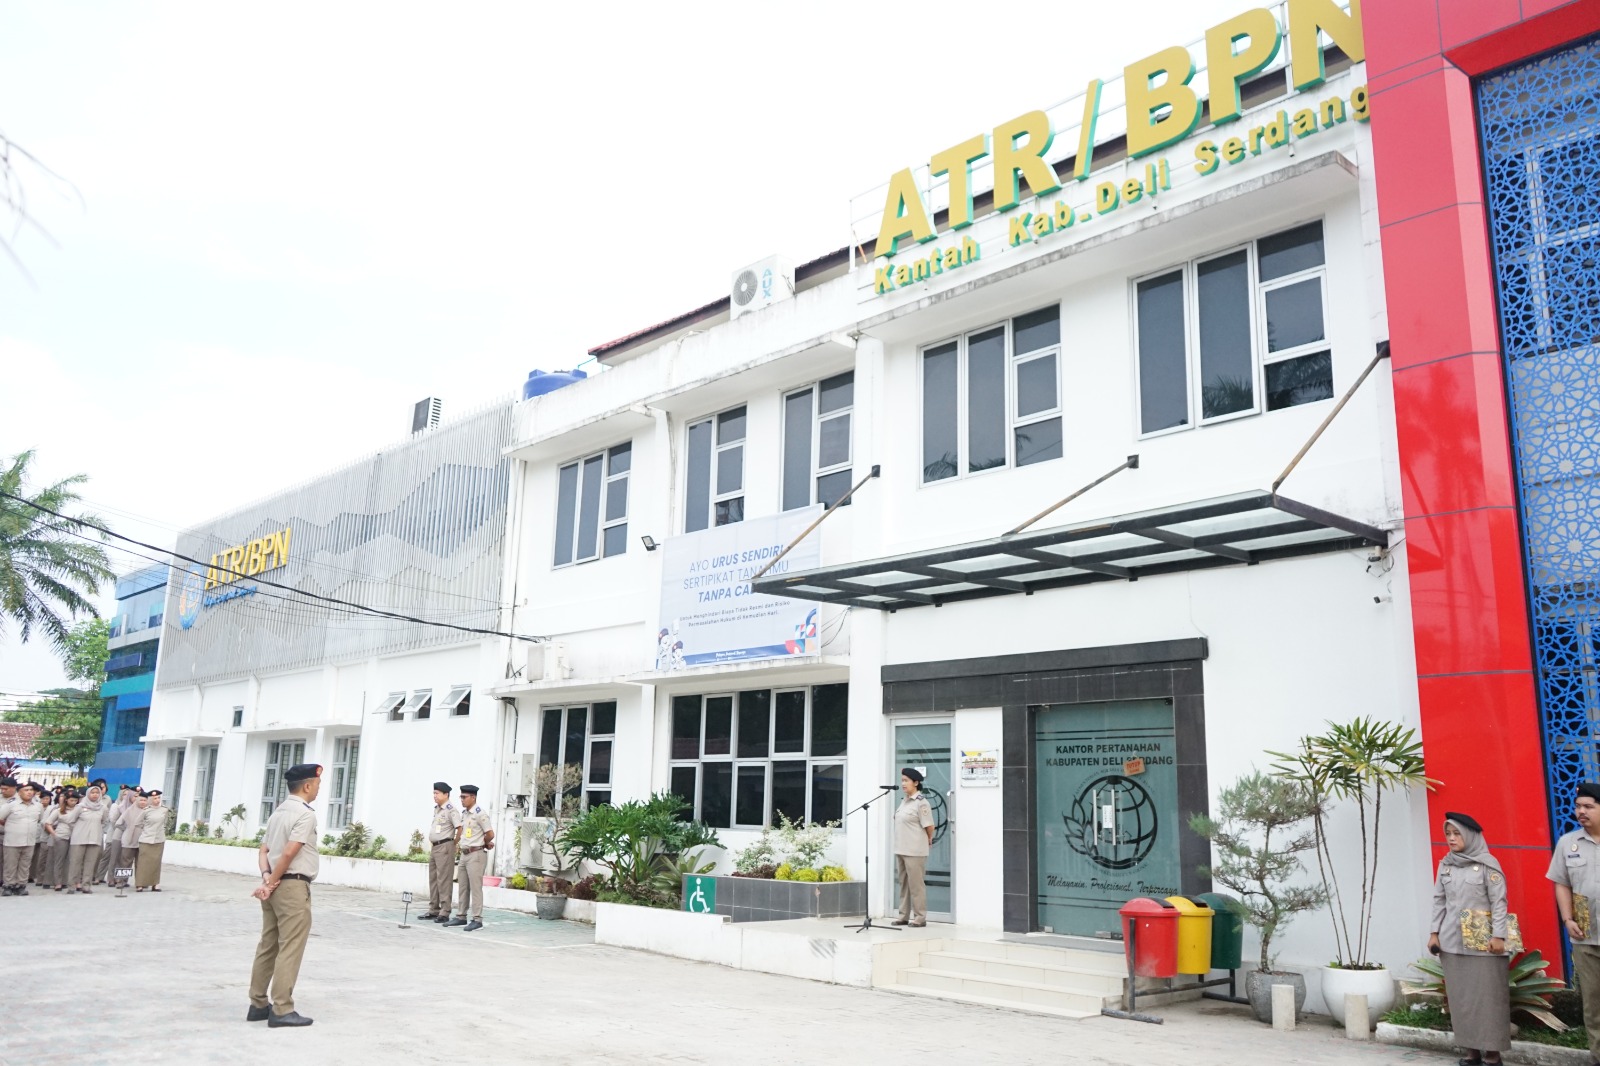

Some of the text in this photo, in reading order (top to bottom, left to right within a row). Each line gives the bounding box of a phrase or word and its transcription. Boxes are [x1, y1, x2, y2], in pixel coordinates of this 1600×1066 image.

[874, 236, 981, 294] Kantah
[1096, 158, 1170, 214] Deli
[1194, 84, 1371, 175] Serdang
[762, 268, 773, 299] AUX
[204, 527, 291, 591] ATR/BPN
[690, 544, 784, 573] AYO URUS SENDIRI
[683, 569, 734, 589] SERTIPIKAT
[698, 586, 732, 603] TANPA
[1056, 743, 1161, 755] KANTOR PERTANAHAN
[1046, 757, 1100, 767] KABUPATEN
[1102, 756, 1124, 766] DELI
[115, 869, 133, 877] ASN
